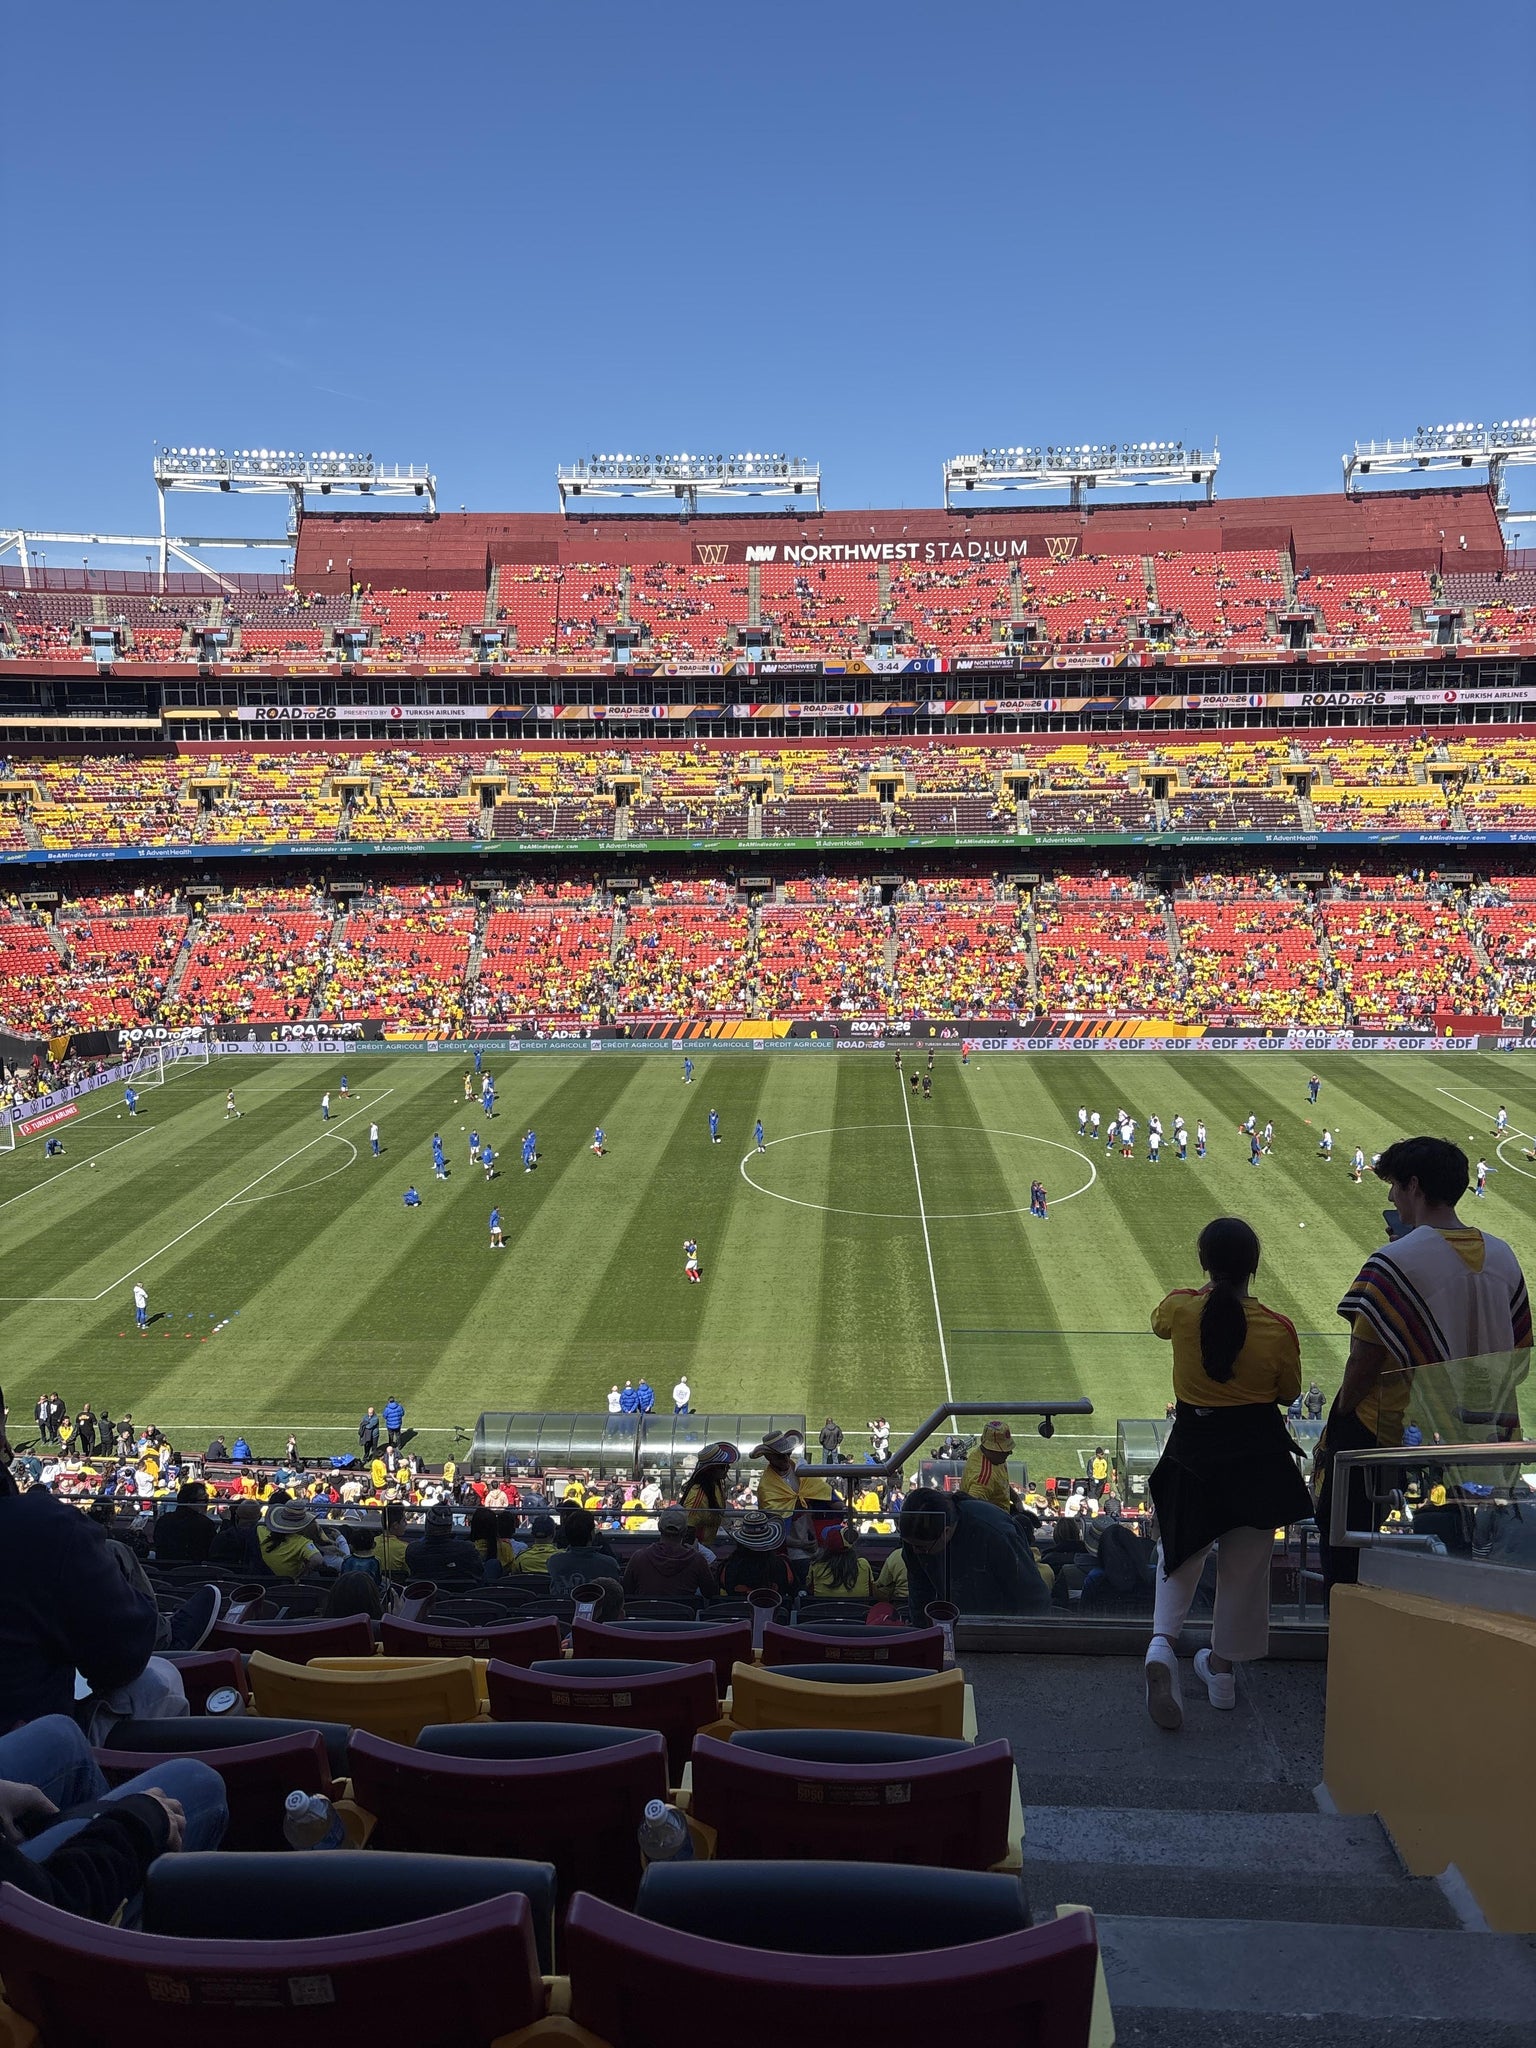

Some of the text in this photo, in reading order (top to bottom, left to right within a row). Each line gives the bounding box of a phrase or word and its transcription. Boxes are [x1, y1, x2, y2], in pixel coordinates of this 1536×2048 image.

[784, 540, 1028, 562] NORTHWEST STADIUM
[854, 663, 860, 671] 0
[878, 662, 899, 671] 3:44
[914, 662, 921, 671] 0
[1302, 693, 1347, 706] ROAD
[1364, 693, 1385, 704] 26
[256, 708, 302, 719] ROAD
[316, 707, 336, 719] 26
[895, 1022, 911, 1031] 26
[118, 1028, 167, 1042] ROAD
[31, 1105, 77, 1130] TURKISH AIRLINES
